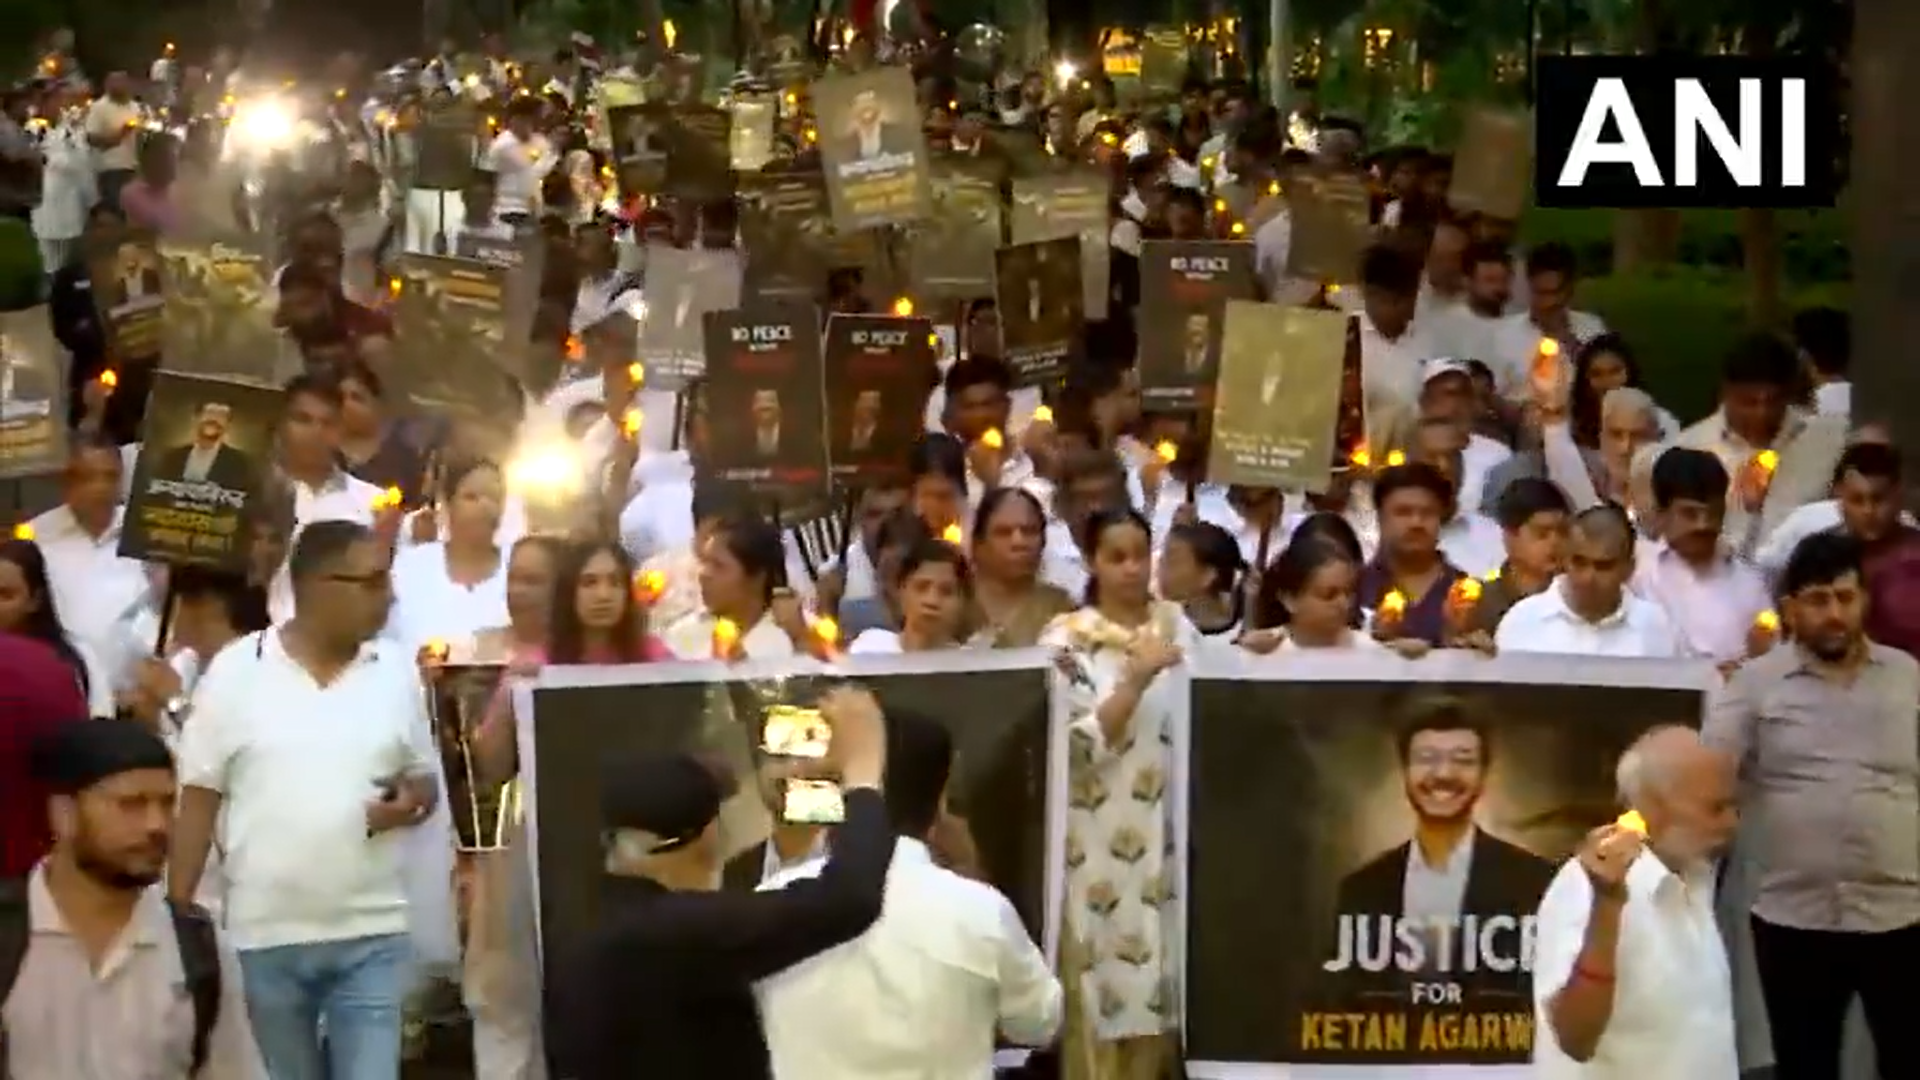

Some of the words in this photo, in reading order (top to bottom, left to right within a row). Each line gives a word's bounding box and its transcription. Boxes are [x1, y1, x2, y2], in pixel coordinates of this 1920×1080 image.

[1411, 982, 1462, 1005] FOR
[1301, 1011, 1408, 1051] KETAN
[1419, 1012, 1533, 1051] AGARW
